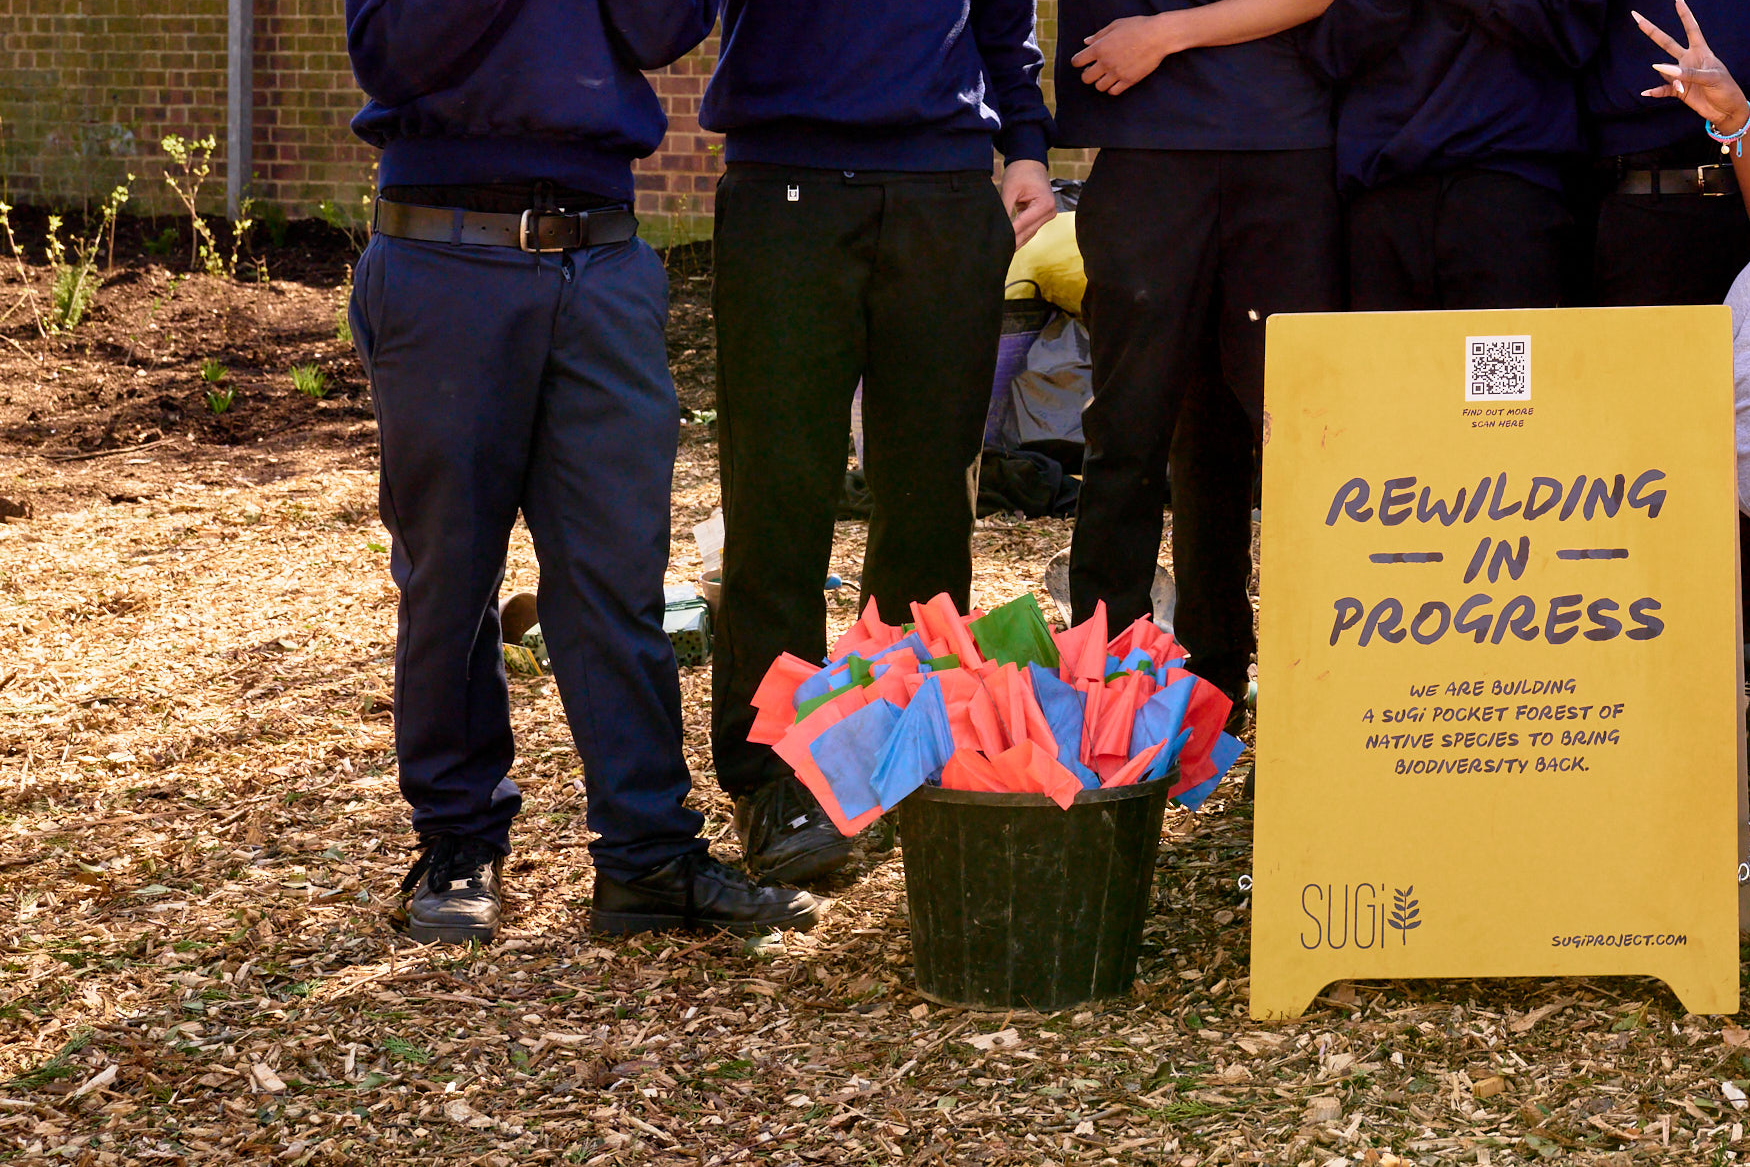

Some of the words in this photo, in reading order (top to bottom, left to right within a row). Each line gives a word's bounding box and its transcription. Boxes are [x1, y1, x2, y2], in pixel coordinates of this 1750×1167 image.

[1462, 408, 1483, 417] FIND
[1485, 408, 1505, 416] OUT
[1506, 407, 1534, 416] MORE
[1471, 420, 1496, 428] SCAN
[1498, 419, 1524, 428] HERE
[1325, 468, 1667, 527] REWILDING
[1463, 535, 1531, 585] IN
[1329, 593, 1665, 648] PROGRESS
[1409, 684, 1440, 698] WE
[1444, 680, 1485, 697] ARE
[1491, 678, 1577, 696] BUILDING
[1362, 708, 1375, 724] A
[1432, 706, 1510, 723] POCKET
[1515, 704, 1593, 721] FOREST
[1598, 703, 1625, 720] OF
[1365, 732, 1434, 750] NATIVE
[1440, 731, 1520, 749] SPECIES
[1528, 731, 1554, 748] TO
[1560, 728, 1620, 747] BRING
[1394, 757, 1529, 775] BIODIVERSITY
[1534, 756, 1590, 773] BACK.
